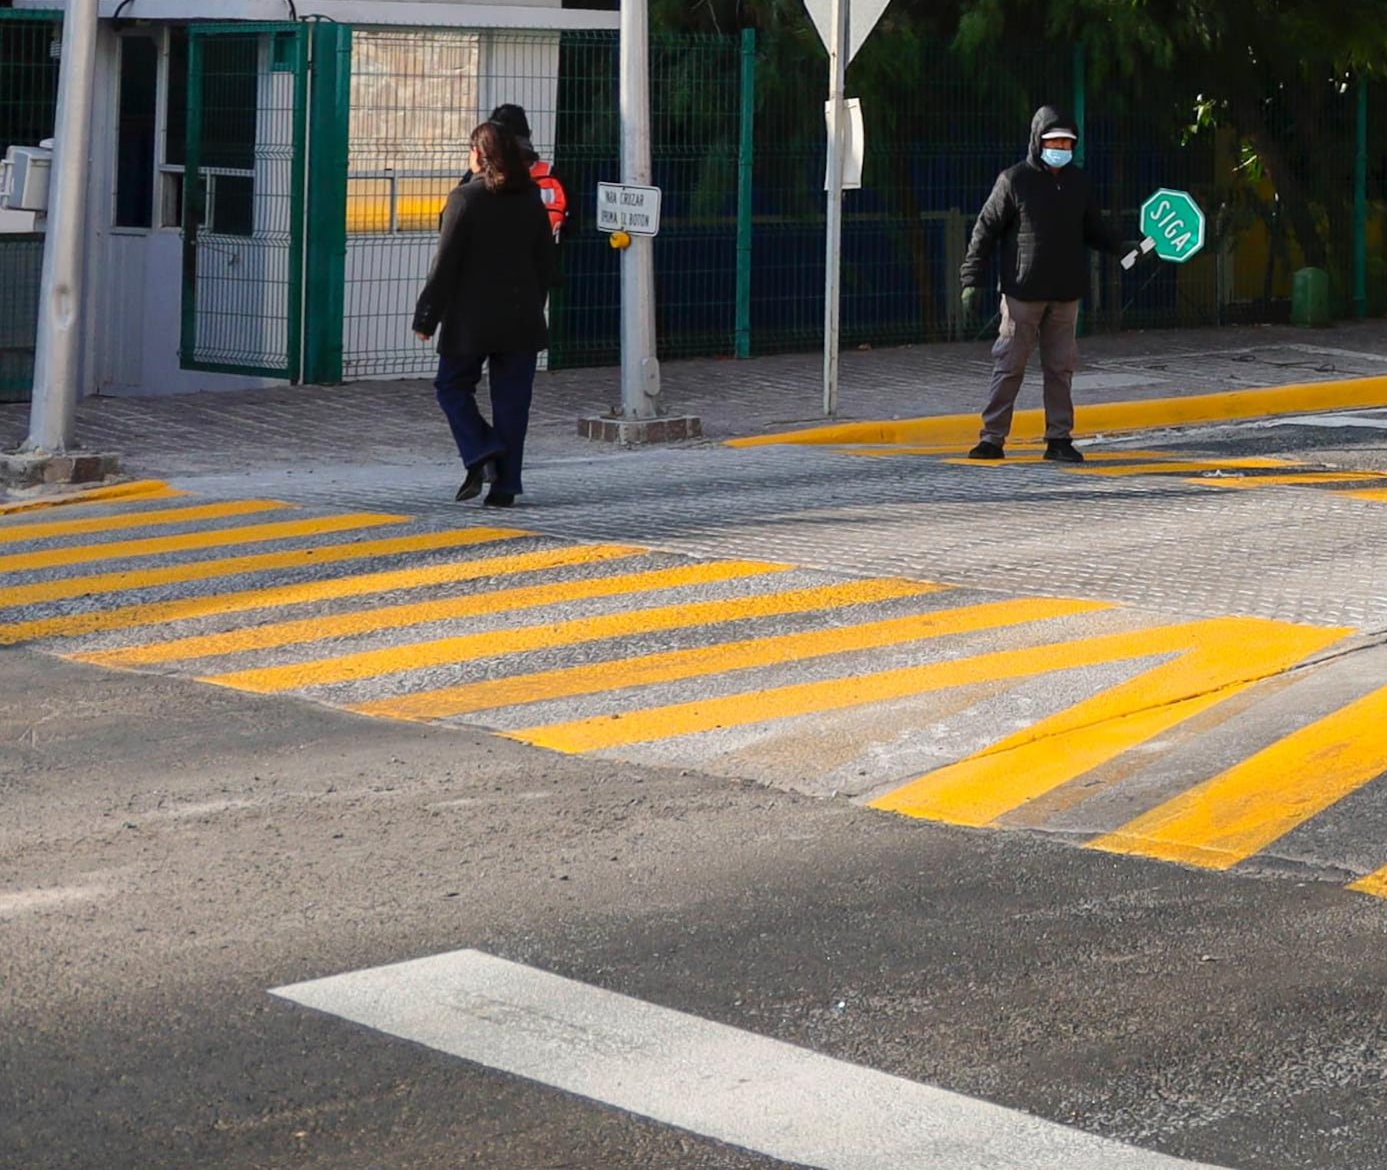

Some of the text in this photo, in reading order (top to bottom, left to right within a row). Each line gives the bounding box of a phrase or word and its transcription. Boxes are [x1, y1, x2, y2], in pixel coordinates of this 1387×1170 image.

[620, 192, 645, 207] CRUZAR
[629, 212, 650, 228] BOTON
[1150, 200, 1192, 252] SIGA
